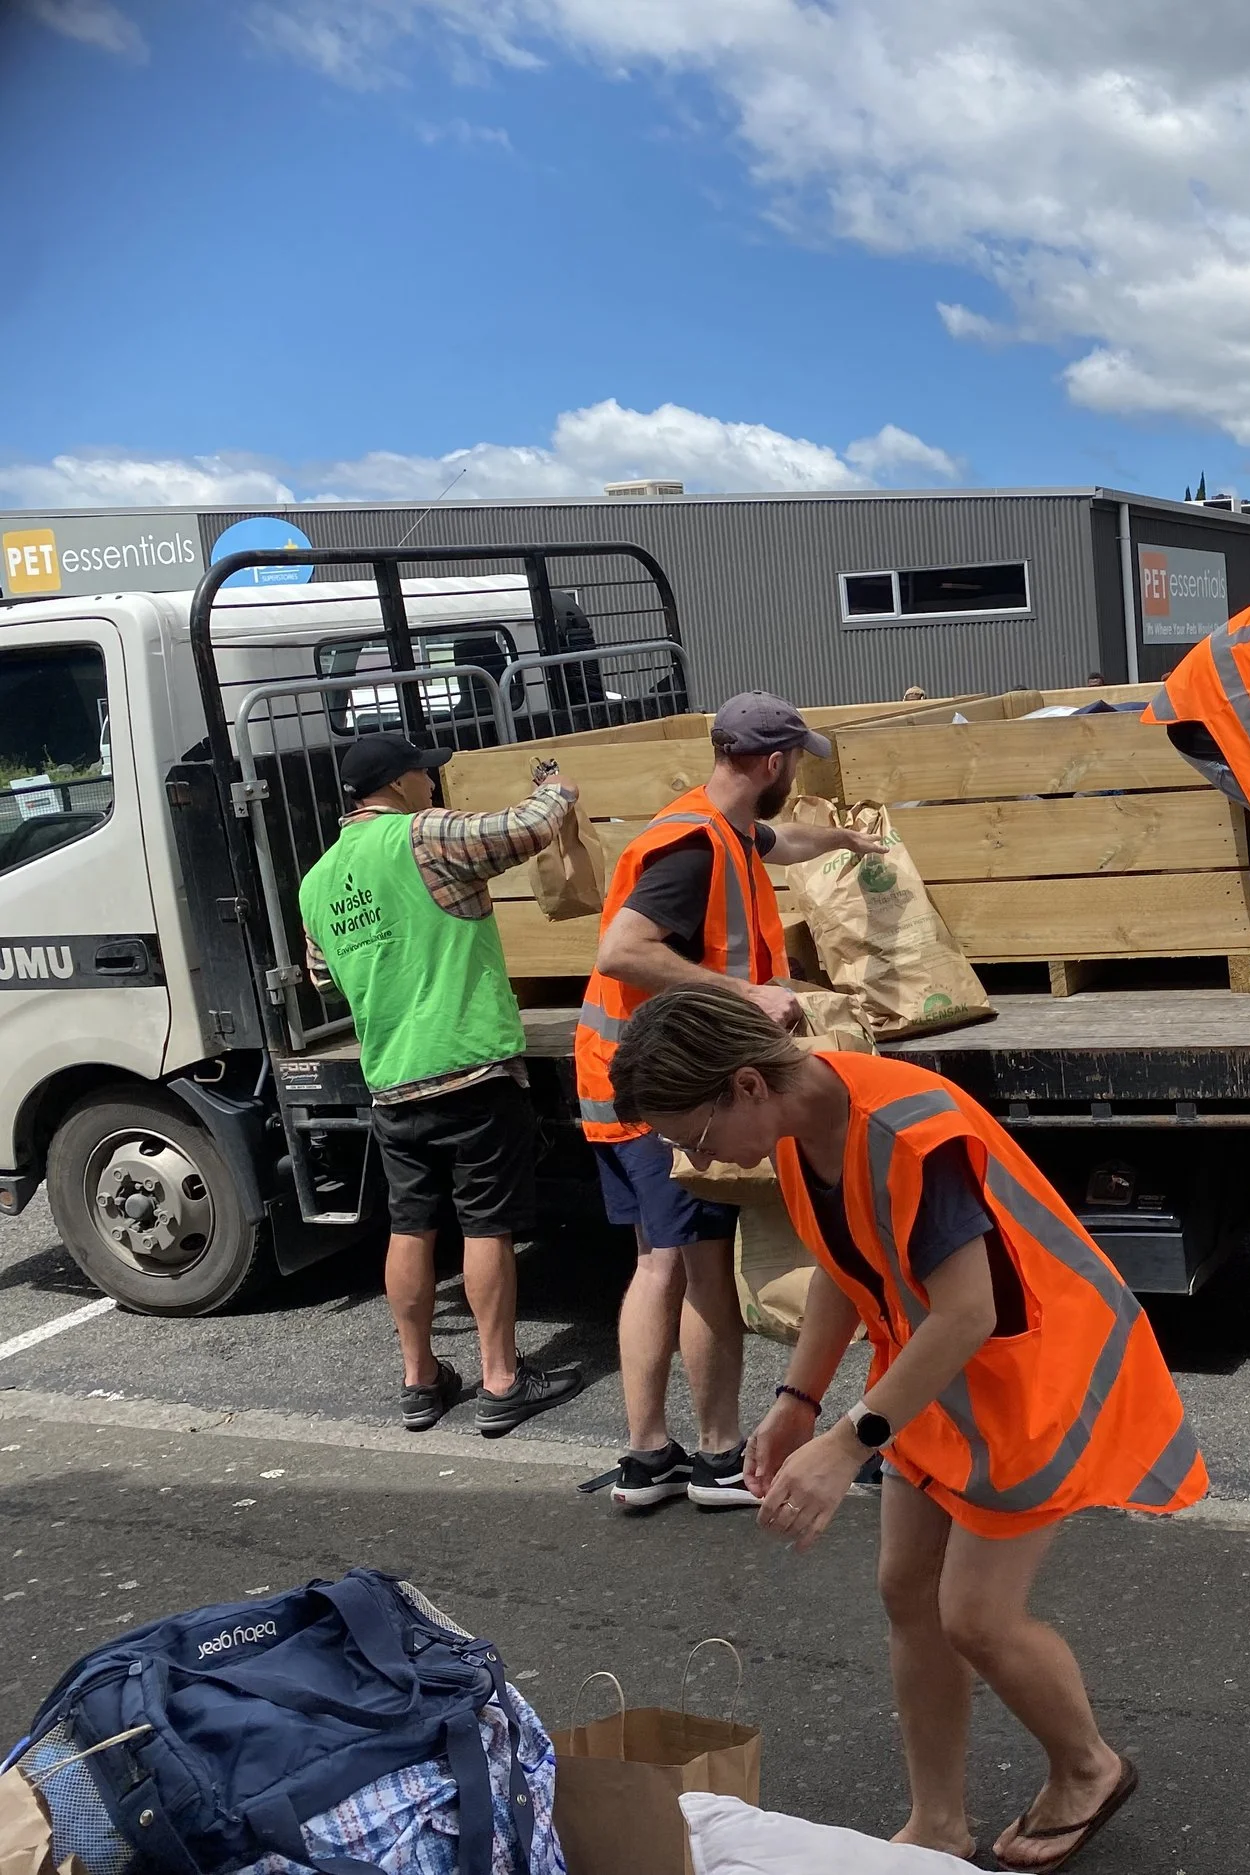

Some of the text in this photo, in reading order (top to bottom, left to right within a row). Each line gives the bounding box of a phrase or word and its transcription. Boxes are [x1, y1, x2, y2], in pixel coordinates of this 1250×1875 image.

[7, 544, 54, 577] PET
[62, 532, 196, 573] essentials
[1144, 568, 1226, 600] PET essentials
[329, 888, 373, 916] waste
[329, 906, 382, 937] warrior
[280, 1061, 321, 1072] FOOT
[197, 1620, 278, 1660] baby gear
